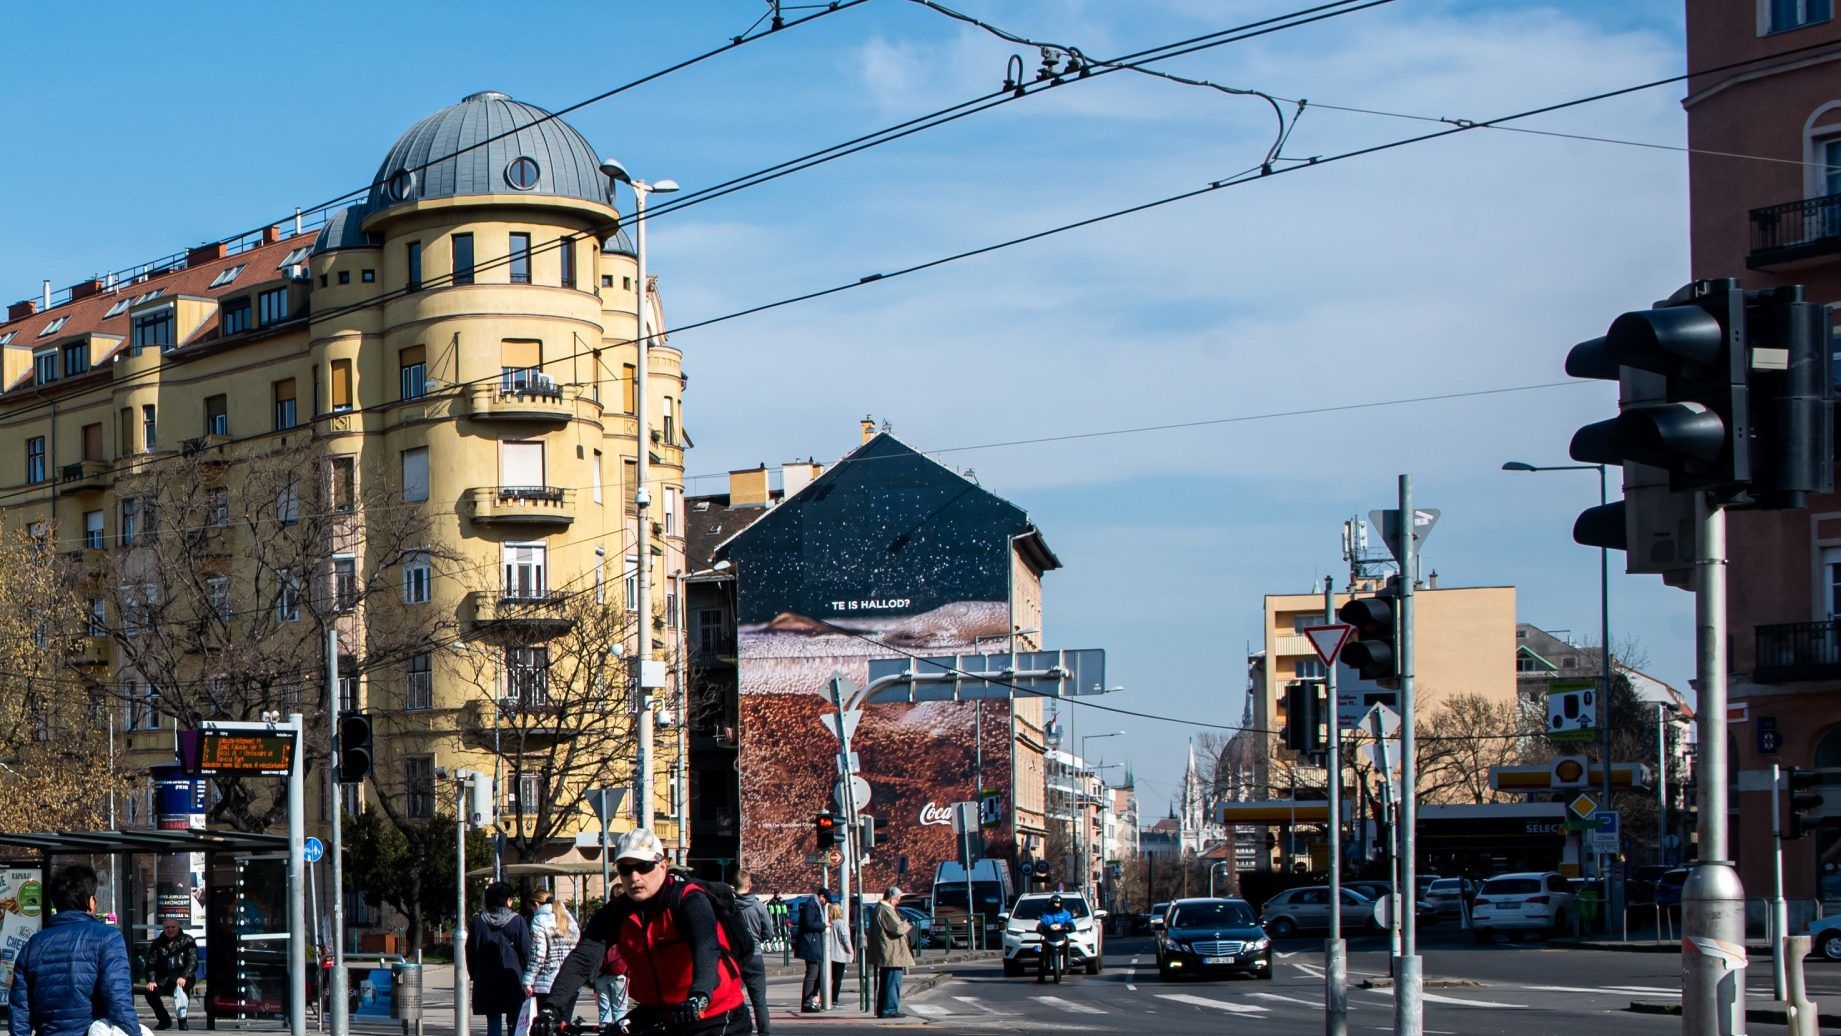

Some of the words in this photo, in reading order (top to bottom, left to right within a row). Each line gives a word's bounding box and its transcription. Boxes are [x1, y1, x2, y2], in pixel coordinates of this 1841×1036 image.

[832, 601, 845, 610] TE
[848, 601, 858, 610] IS
[861, 599, 910, 609] HALLOD?
[920, 802, 952, 826] Coca
